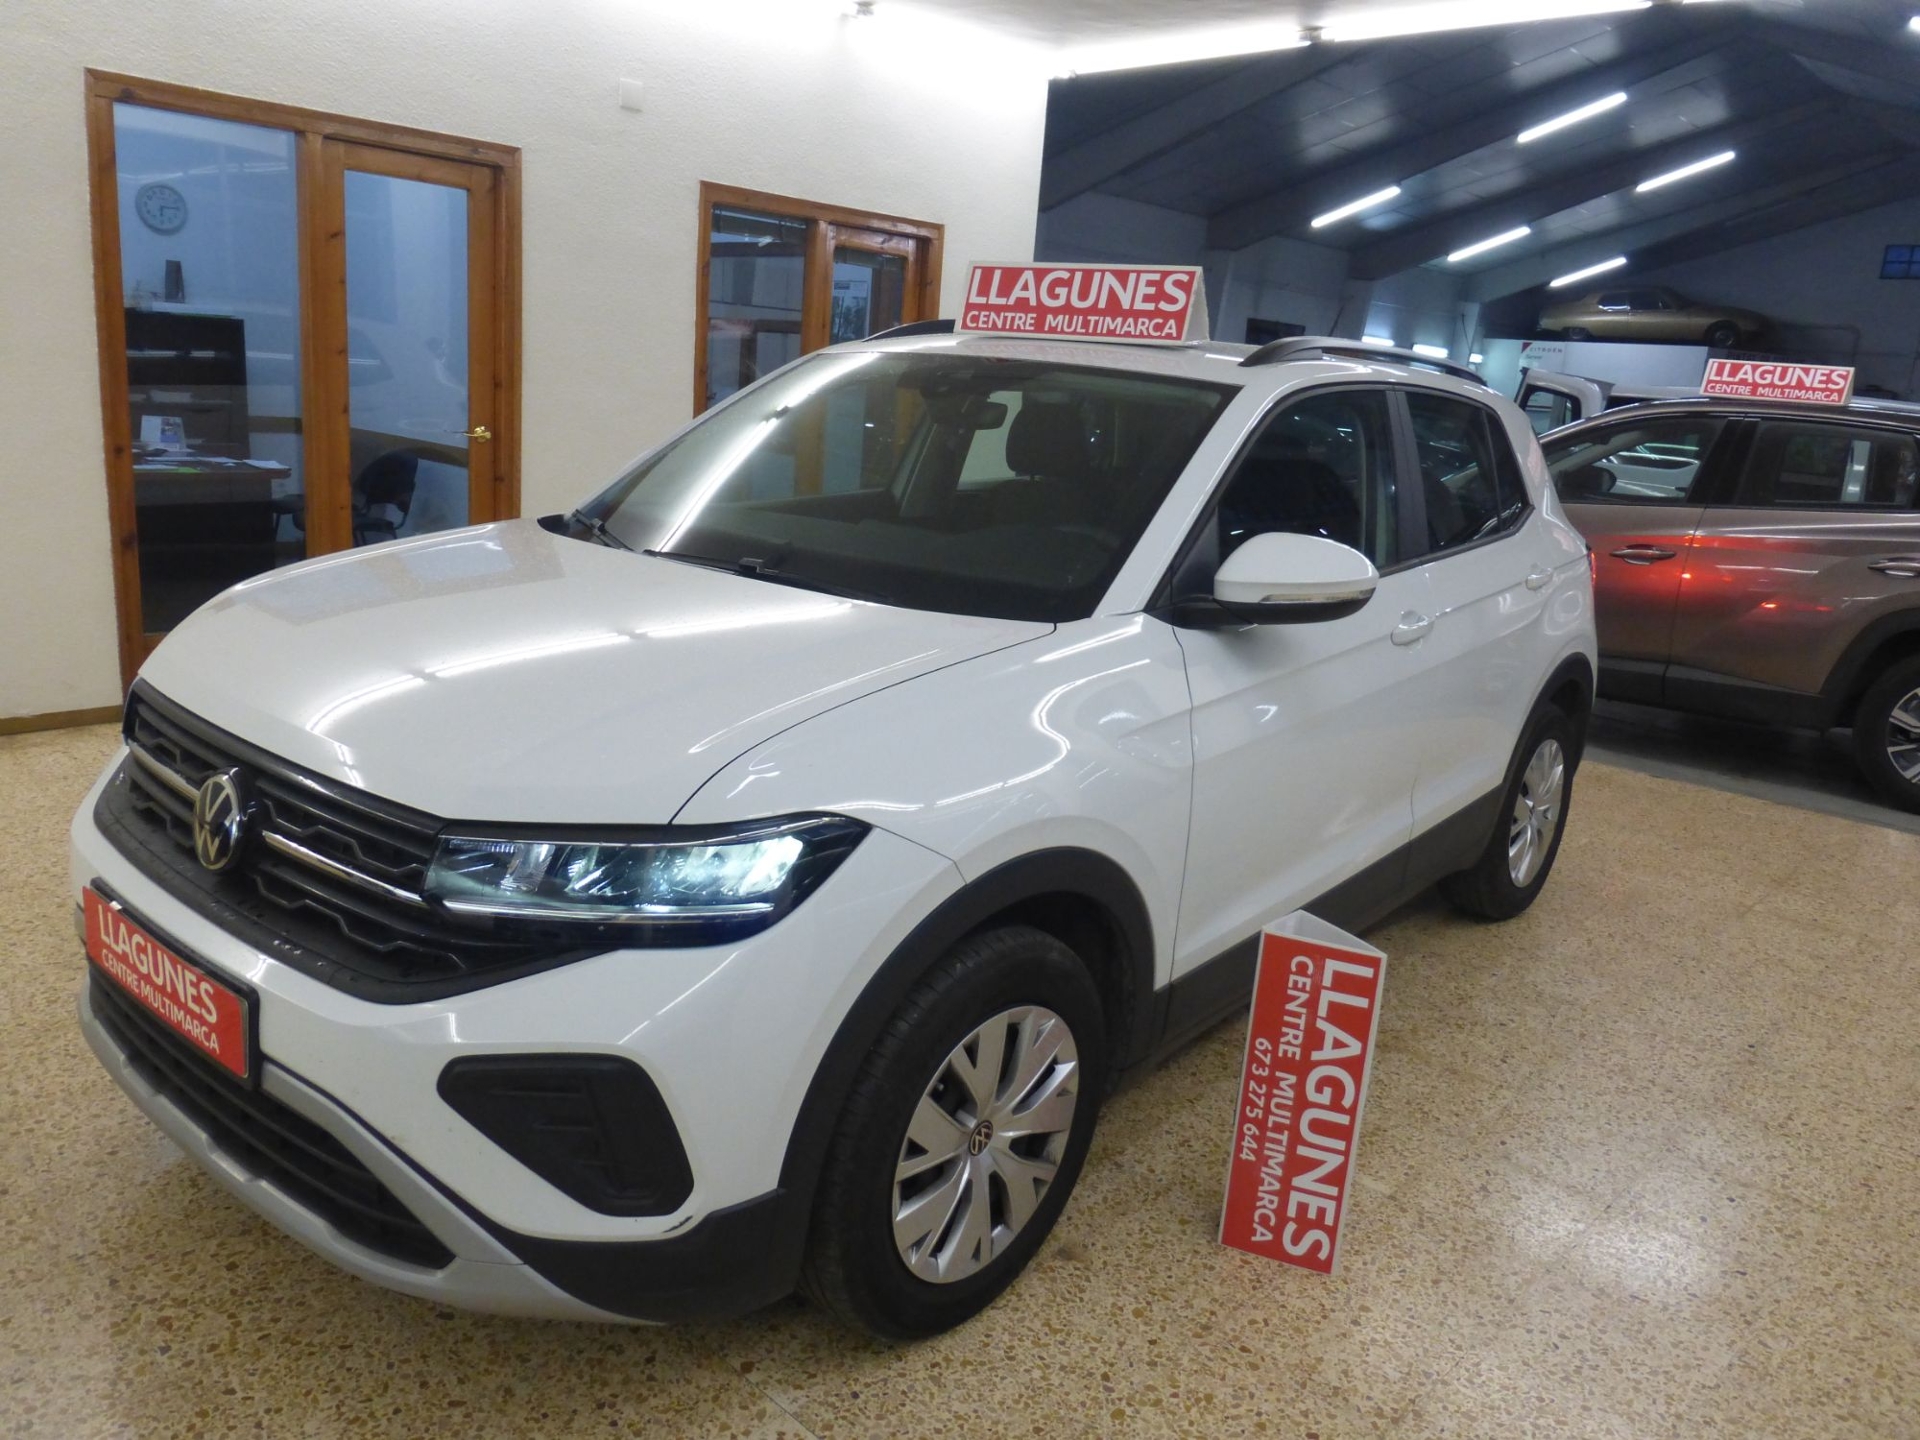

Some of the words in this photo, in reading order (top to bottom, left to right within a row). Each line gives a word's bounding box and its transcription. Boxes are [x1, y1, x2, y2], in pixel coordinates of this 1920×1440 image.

[968, 268, 1190, 312] LLAGUNES
[966, 310, 1037, 330] CENTRE
[1044, 314, 1177, 337] MULTIMARCA
[1707, 382, 1752, 396] CENTRE
[1756, 386, 1839, 402] MULTIMARCA
[1708, 361, 1848, 390] LLAGUNES
[98, 904, 218, 1024] LLAGUNES
[102, 948, 140, 992] CENTRE
[140, 979, 220, 1055] MULTIMARCA
[1277, 954, 1314, 1061] CENTRE
[1251, 1037, 1273, 1077] 673
[1245, 1079, 1266, 1117] 275
[1281, 957, 1374, 1263] LLAGUNES
[1239, 1122, 1259, 1163] 644
[1250, 1071, 1297, 1243] MULTIMARCA
